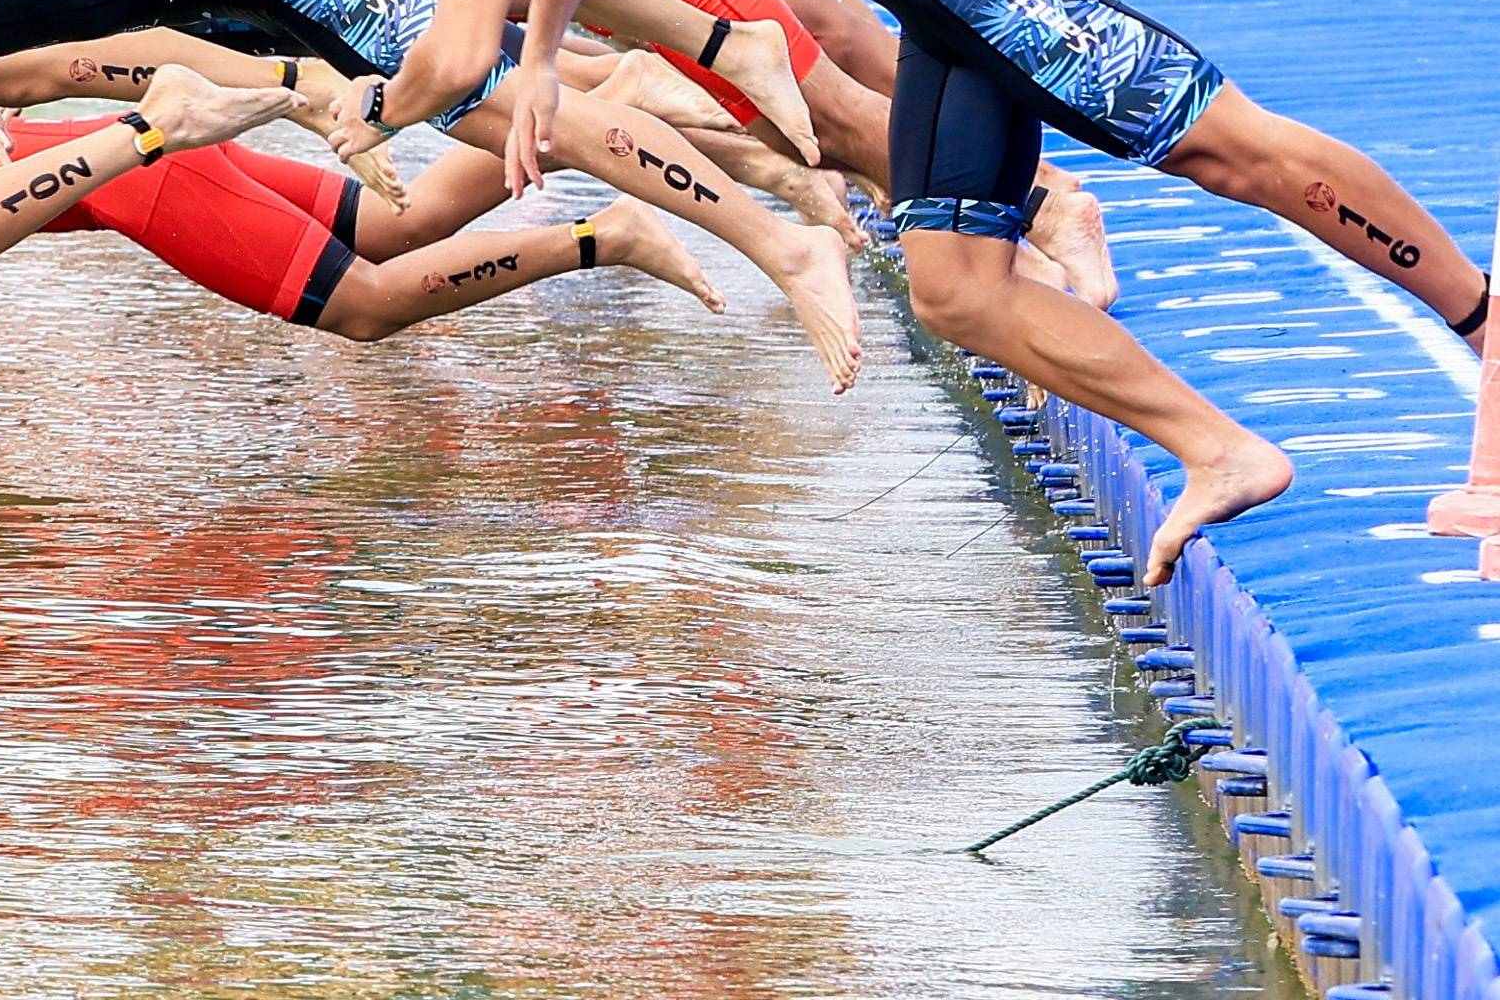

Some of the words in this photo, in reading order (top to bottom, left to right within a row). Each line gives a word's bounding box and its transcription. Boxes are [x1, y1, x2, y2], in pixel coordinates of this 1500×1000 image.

[0, 155, 94, 215] 102
[637, 147, 721, 204] 101
[1337, 203, 1421, 269] 116
[447, 252, 520, 288] 134
